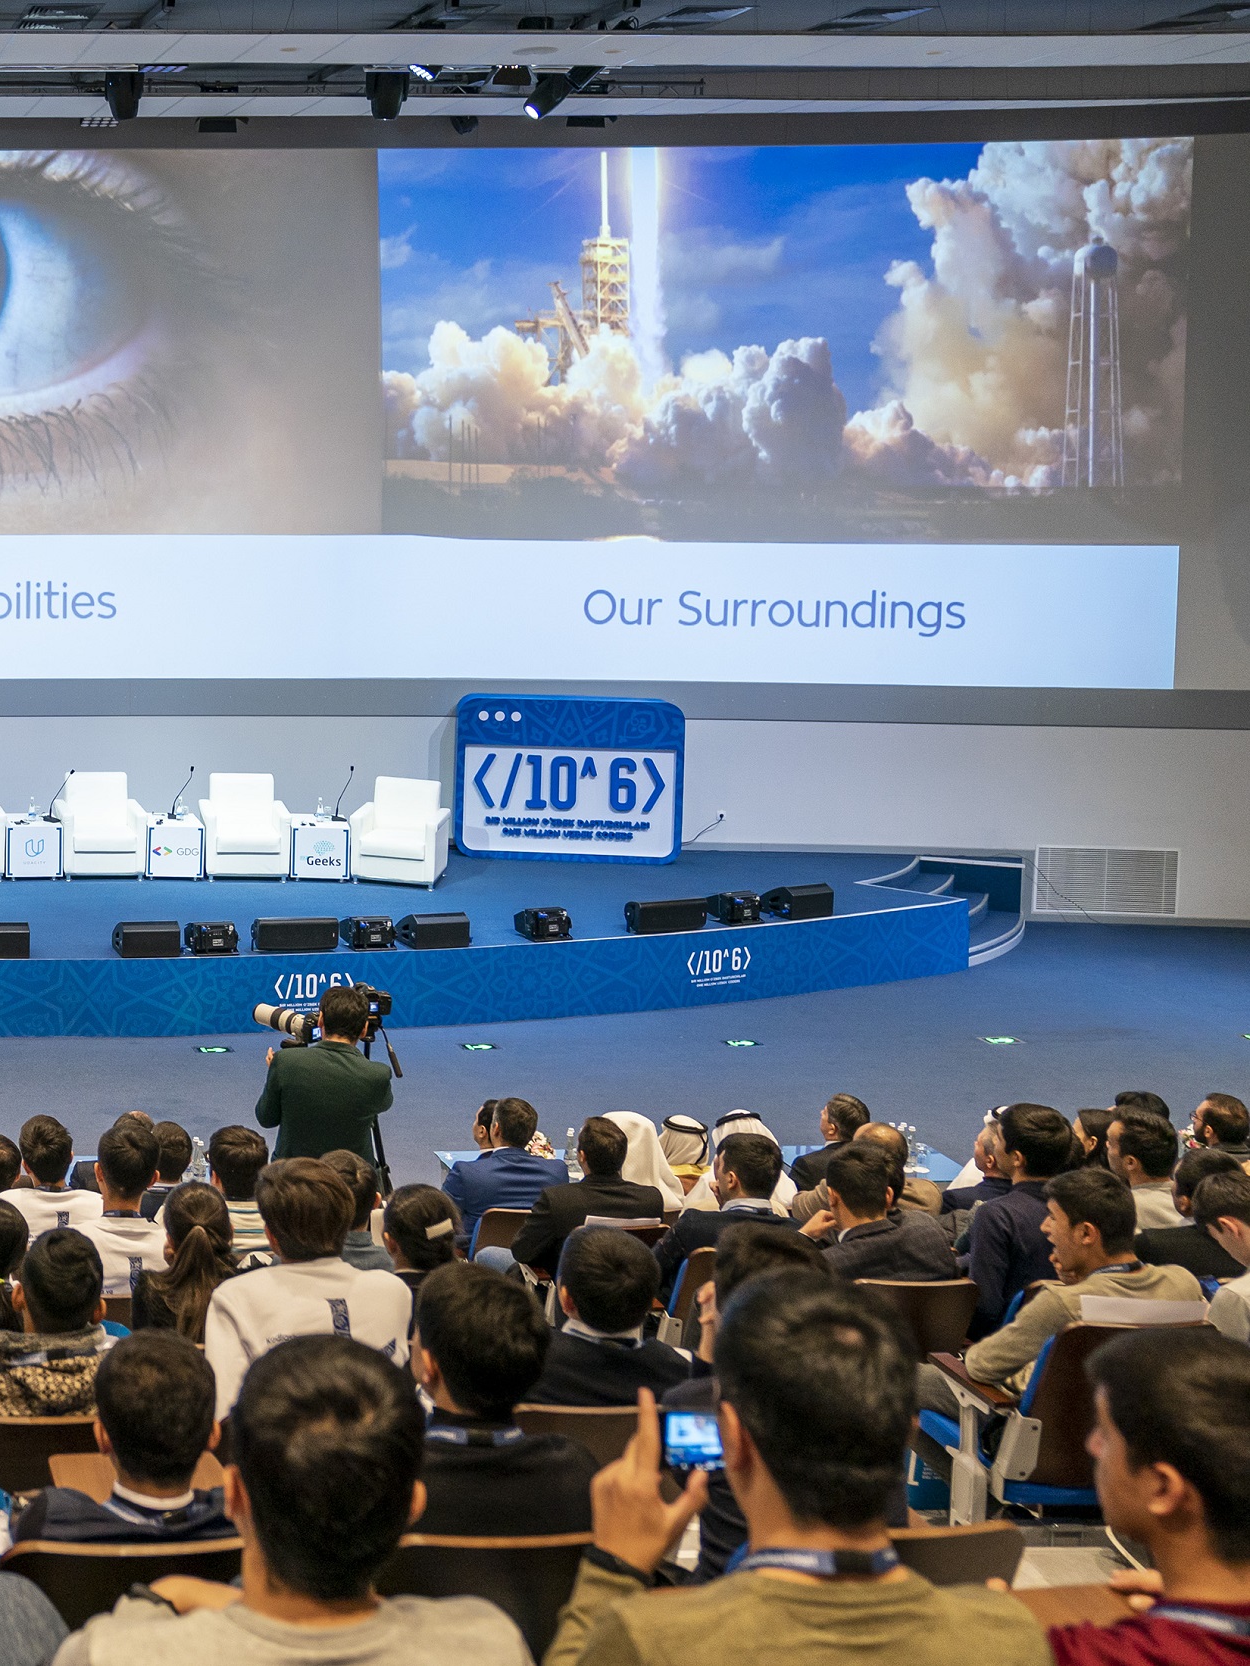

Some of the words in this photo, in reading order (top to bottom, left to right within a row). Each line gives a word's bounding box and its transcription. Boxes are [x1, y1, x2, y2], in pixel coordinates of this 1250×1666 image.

[583, 589, 662, 625] Our
[678, 589, 966, 637] Surroundings
[502, 817, 539, 826] MILLION
[502, 827, 521, 836] ONE
[524, 828, 560, 838] MILLION
[176, 847, 200, 857] GDG
[306, 855, 342, 867] Geeks
